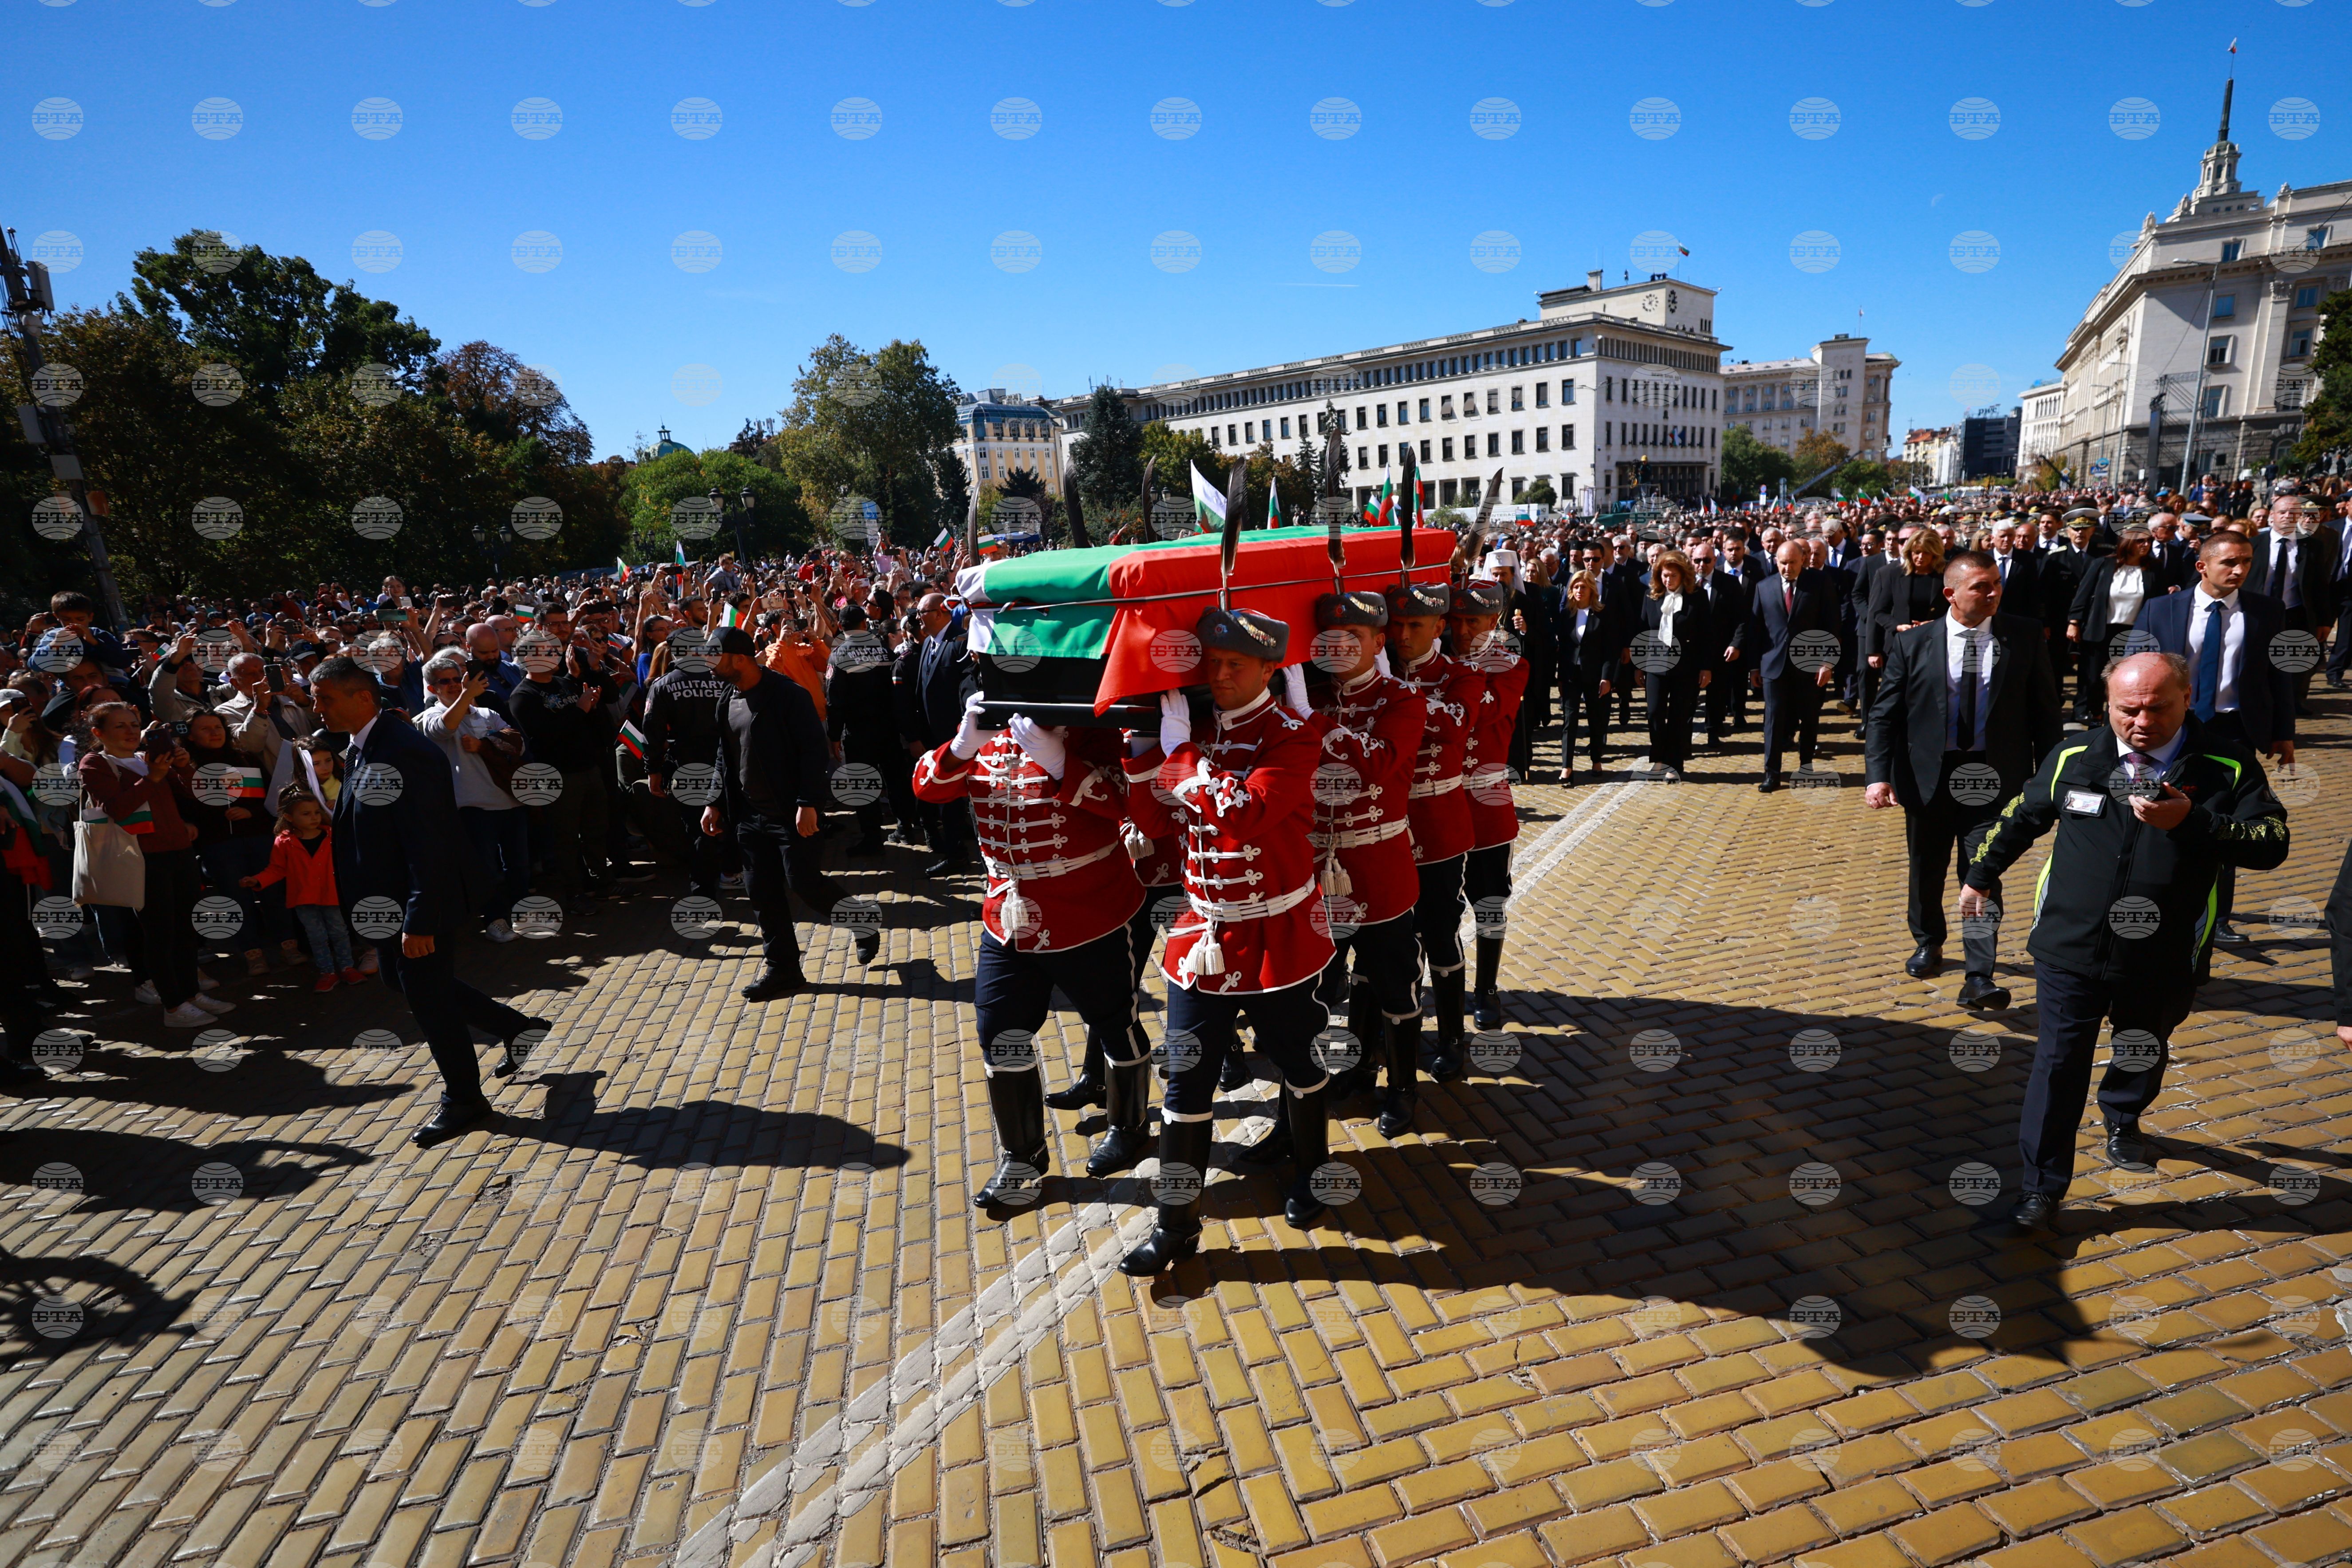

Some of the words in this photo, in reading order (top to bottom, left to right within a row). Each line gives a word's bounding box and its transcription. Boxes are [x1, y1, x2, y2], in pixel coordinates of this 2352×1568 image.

[1978, 407, 1997, 416] pwc
[848, 647, 888, 658] MILITARY
[854, 654, 889, 664] POLICE
[667, 680, 725, 692] MILITARY
[673, 689, 722, 700] POLICE
